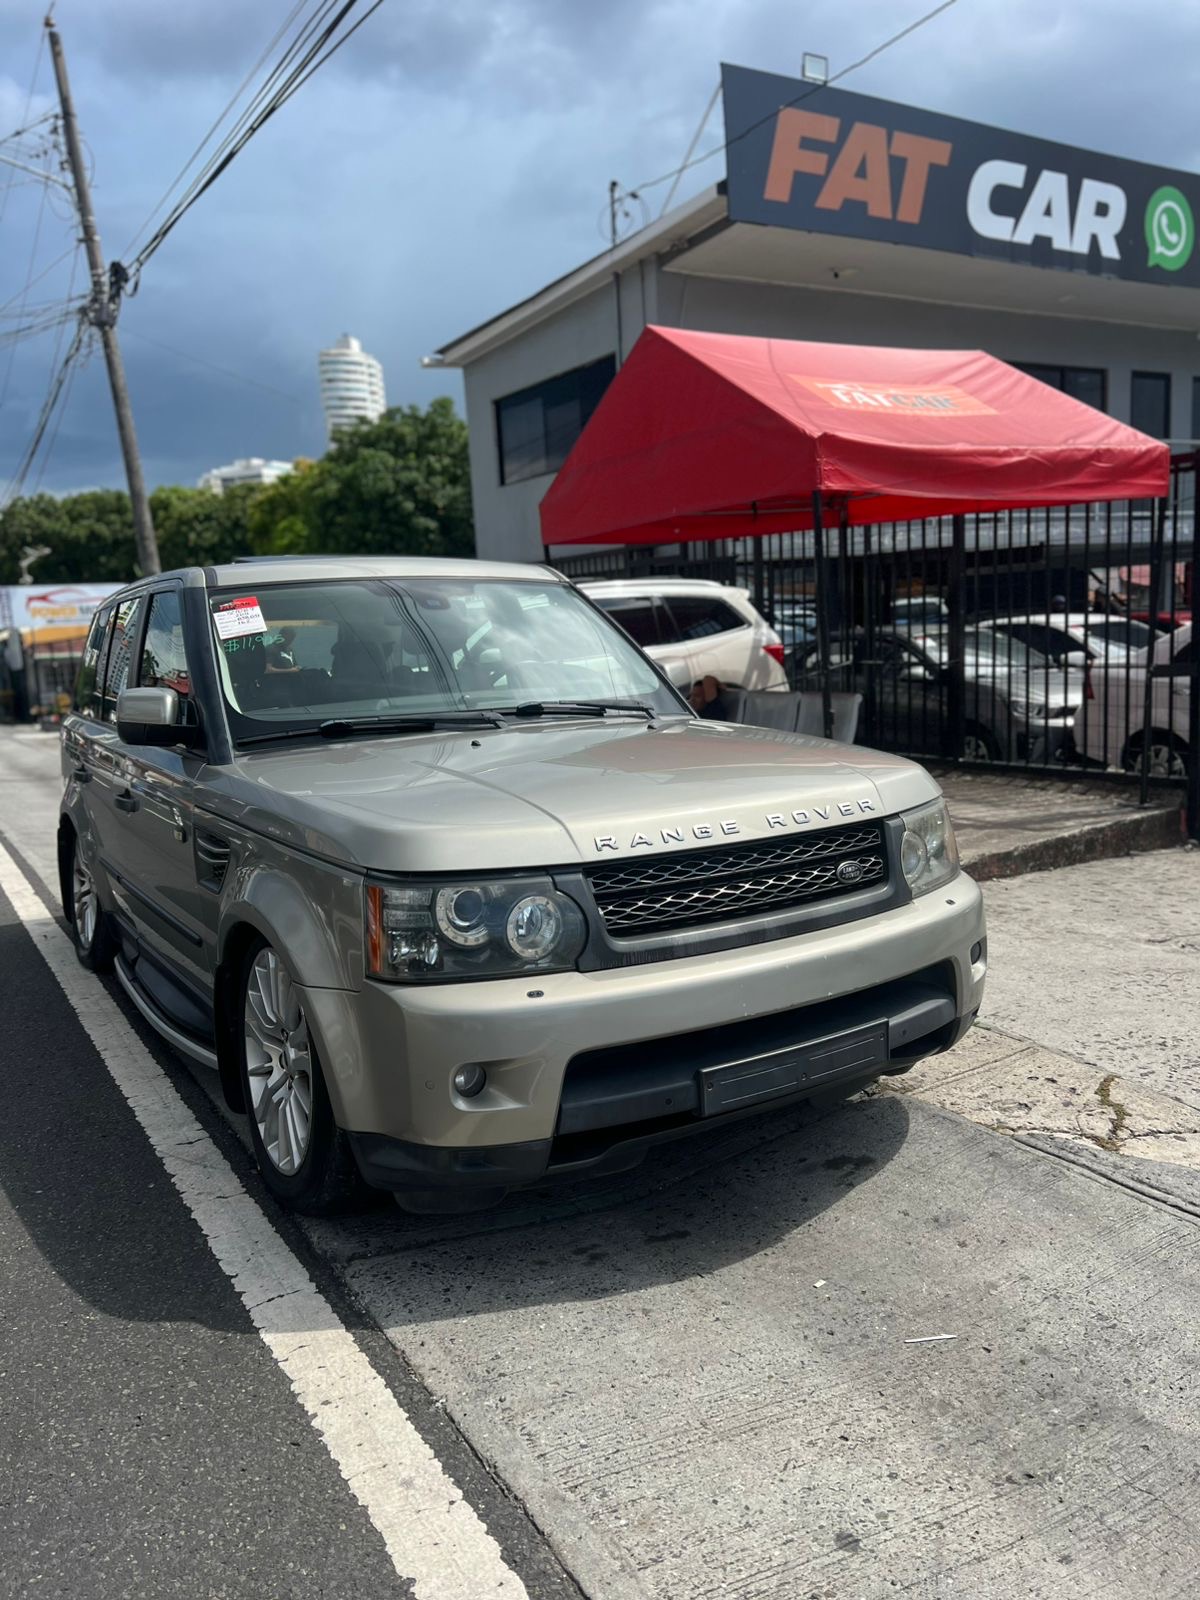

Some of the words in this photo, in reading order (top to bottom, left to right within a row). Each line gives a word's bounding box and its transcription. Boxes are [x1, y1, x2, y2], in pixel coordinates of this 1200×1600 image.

[763, 107, 952, 224] FAT
[967, 159, 1127, 260] CAR
[594, 819, 741, 851] RANGE
[765, 799, 876, 829] ROVER
